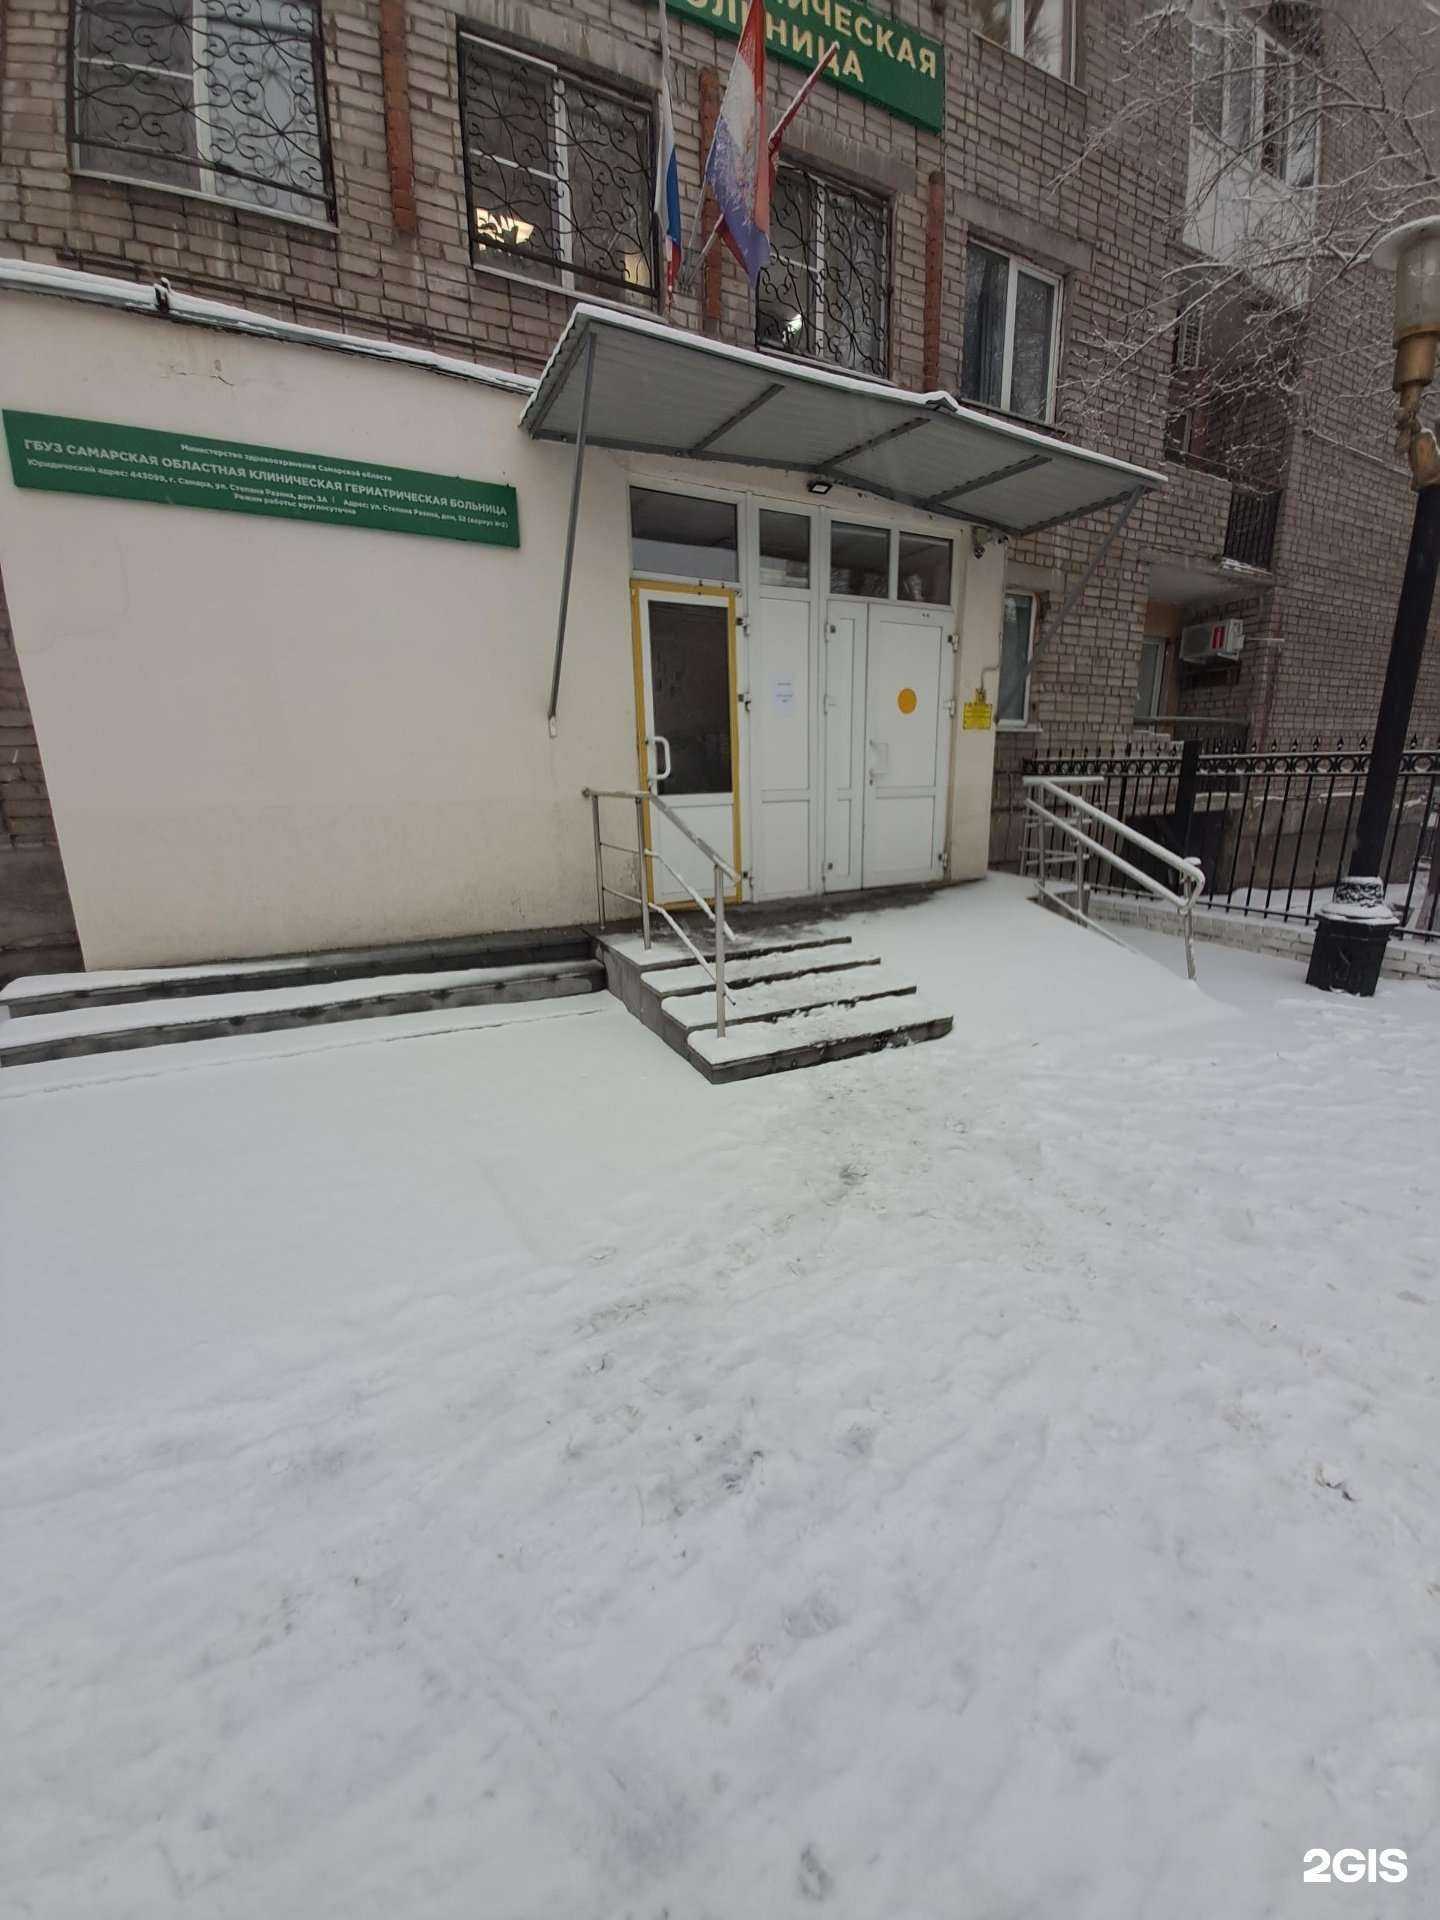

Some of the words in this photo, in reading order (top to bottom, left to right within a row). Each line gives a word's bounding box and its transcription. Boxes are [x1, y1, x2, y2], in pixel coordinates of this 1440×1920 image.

[23, 439, 64, 454] ГБУЗ
[67, 445, 159, 466] САМАРСКАЯ
[163, 458, 246, 477] ОБЛАСТНАЯ
[250, 471, 342, 490] КЛИНИЧЕСКАЯ
[346, 484, 448, 505] ГЕРИАТРИЧЕСКАЯ
[451, 499, 507, 515] БОЛЬНИЦА
